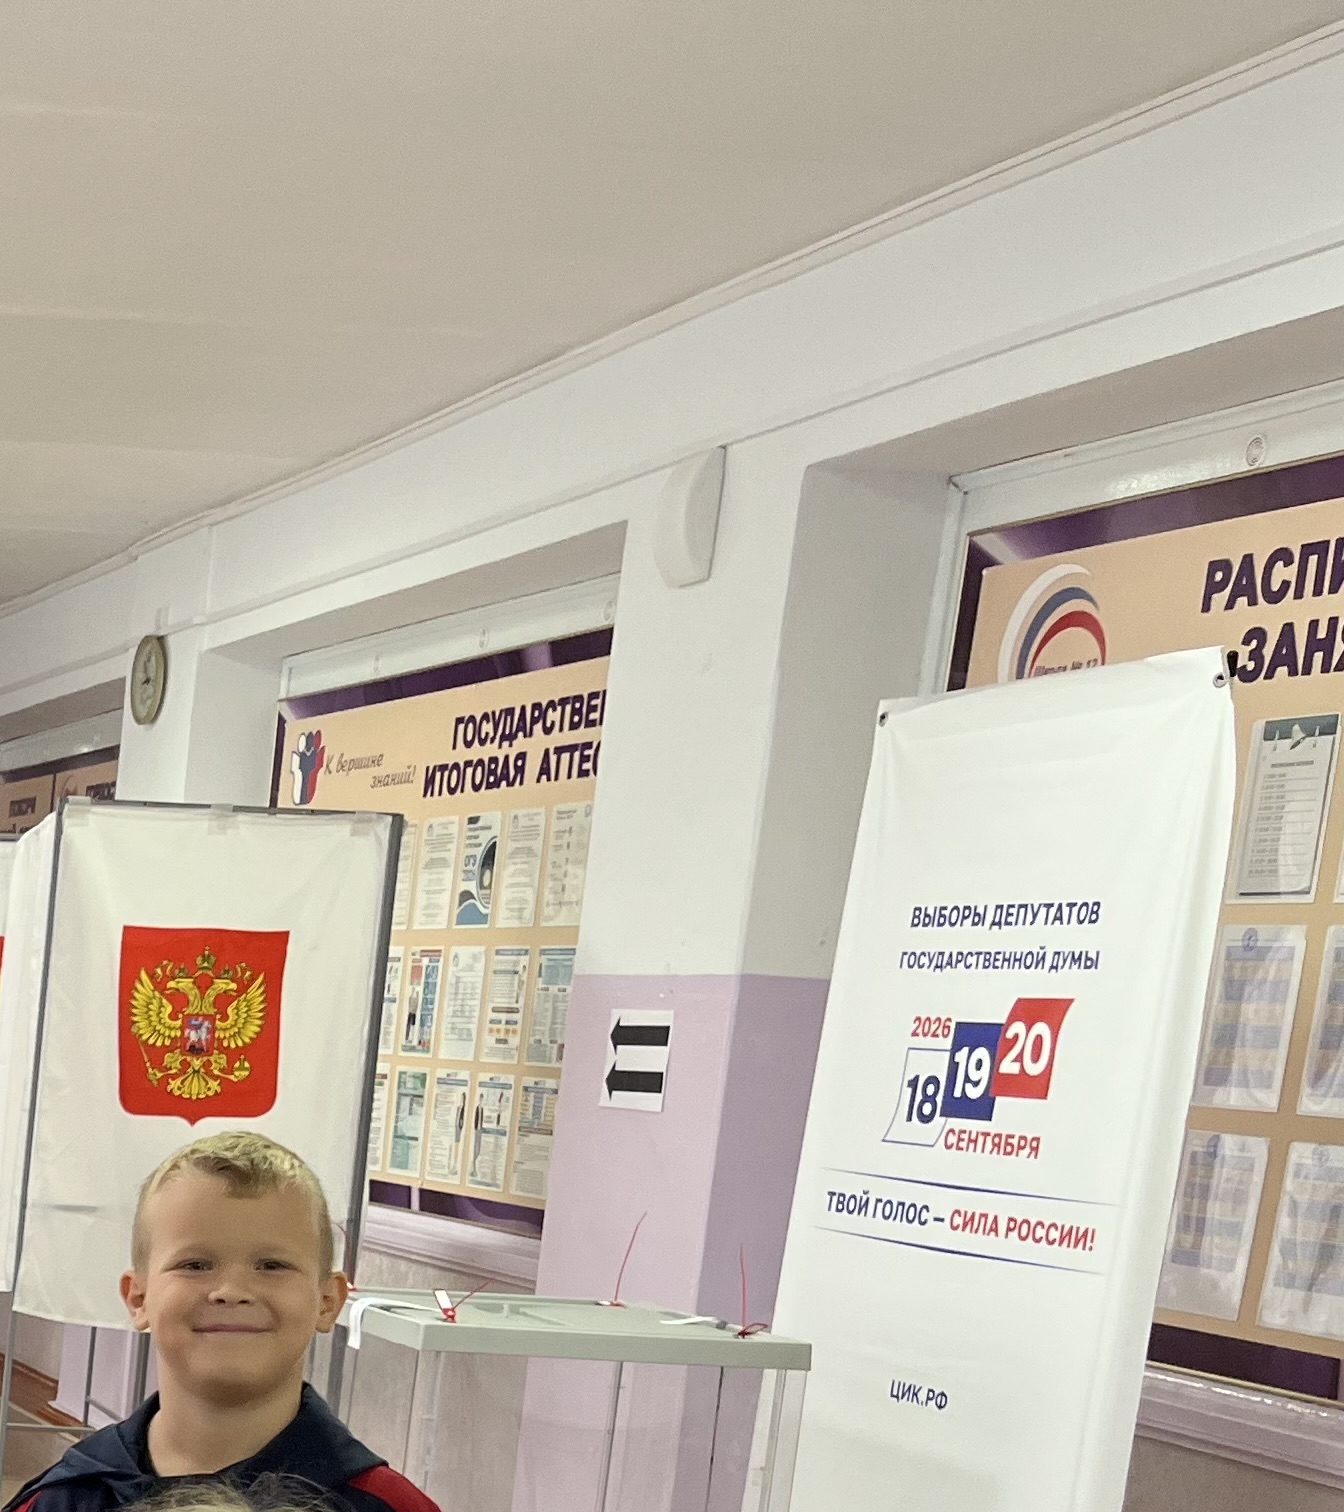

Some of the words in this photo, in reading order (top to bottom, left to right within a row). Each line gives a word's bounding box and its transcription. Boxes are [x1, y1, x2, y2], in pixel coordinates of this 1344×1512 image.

[1237, 616, 1344, 683] ЗАН
[335, 753, 384, 776] вершине
[370, 765, 416, 789] знаний!
[422, 751, 527, 798] ИТОГОВАЯ
[910, 905, 988, 928] ВЫБОРЫ
[989, 901, 1101, 930] ДЕПУТАТОВ
[899, 946, 1047, 972] ГОСУДАРСТВЕННОЙ
[1048, 950, 1100, 973] ДУМЫ
[910, 1016, 952, 1040] 2026
[905, 1074, 941, 1125] 18
[953, 1046, 992, 1100] 19
[998, 1020, 1052, 1077] 20
[943, 1127, 1042, 1160] СЕНТЯБРЯ
[826, 1190, 870, 1218] ТВОЙ
[872, 1198, 930, 1226] ГОЛОС
[949, 1208, 1000, 1238] СИЛА
[1004, 1216, 1097, 1252] РОССИИ!
[889, 1379, 948, 1411] ЦИК.РФ
